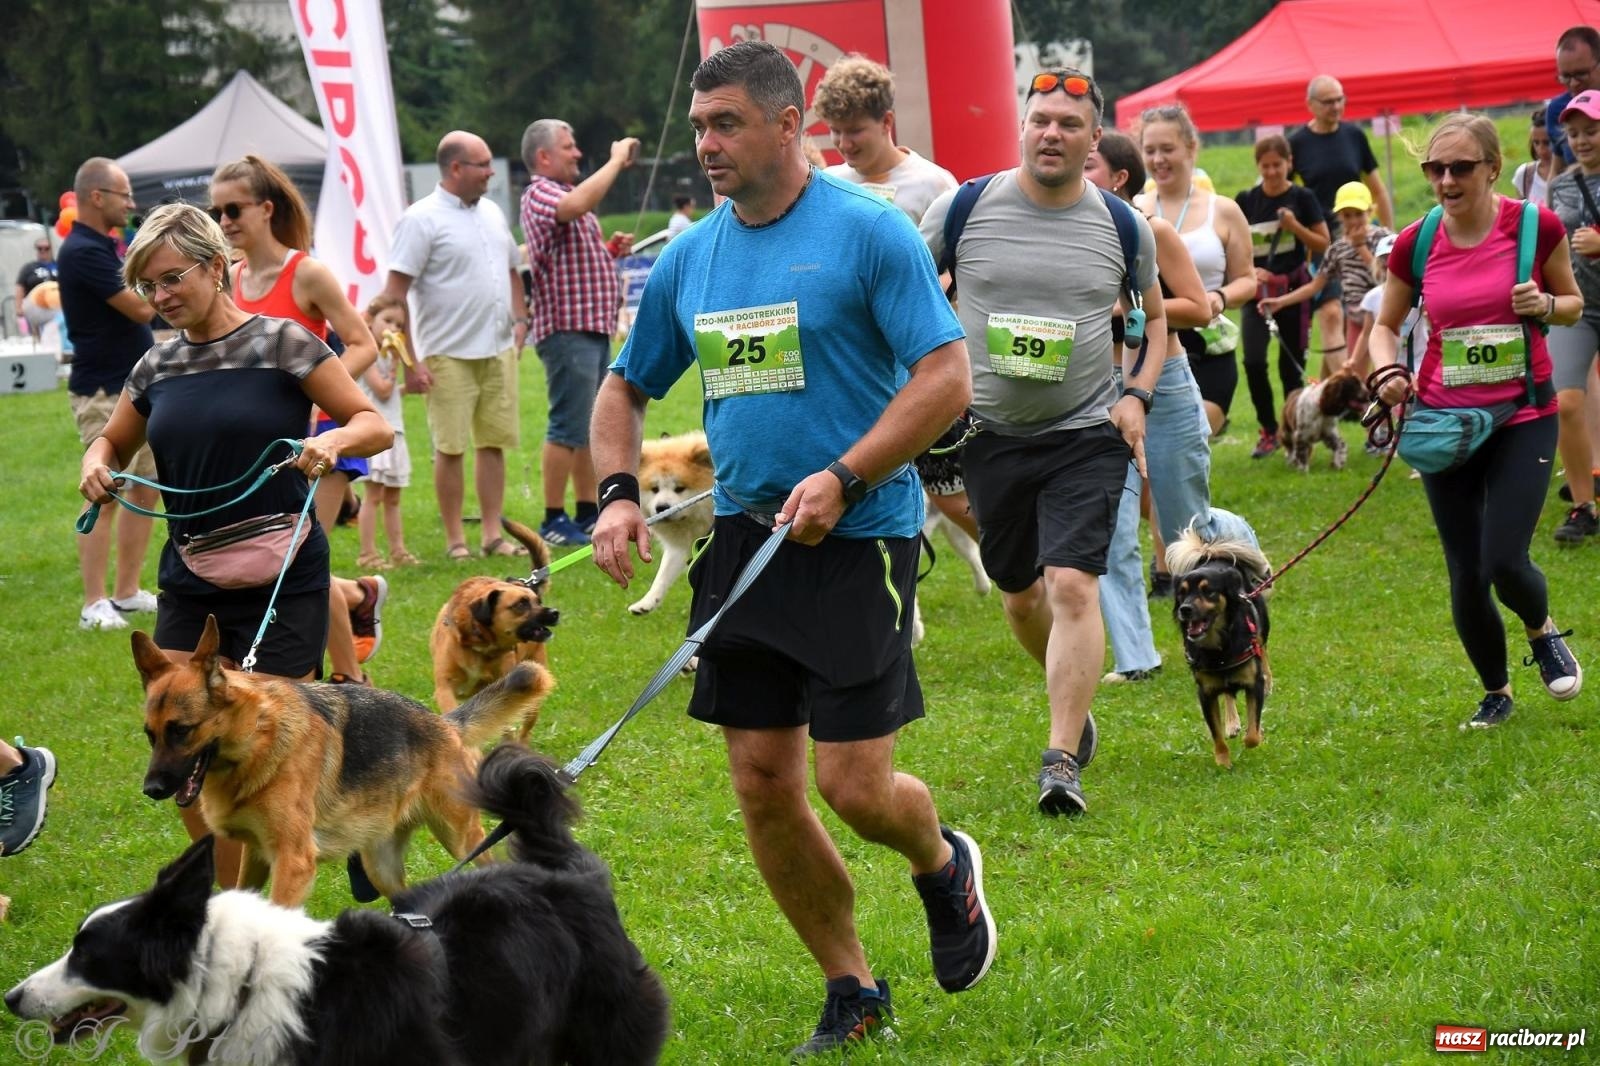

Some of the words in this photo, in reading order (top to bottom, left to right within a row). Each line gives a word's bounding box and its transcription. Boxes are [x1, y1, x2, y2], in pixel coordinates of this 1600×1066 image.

[696, 315, 735, 326] ZOO-MAR
[736, 307, 796, 321] DOGTREKKING
[736, 318, 776, 331] RACIBÓRZ
[776, 316, 797, 326] 2023
[726, 335, 766, 366] 25
[783, 350, 800, 358] ZOO
[1011, 336, 1046, 359] 59
[1466, 344, 1498, 365] 60
[11, 362, 26, 389] 2
